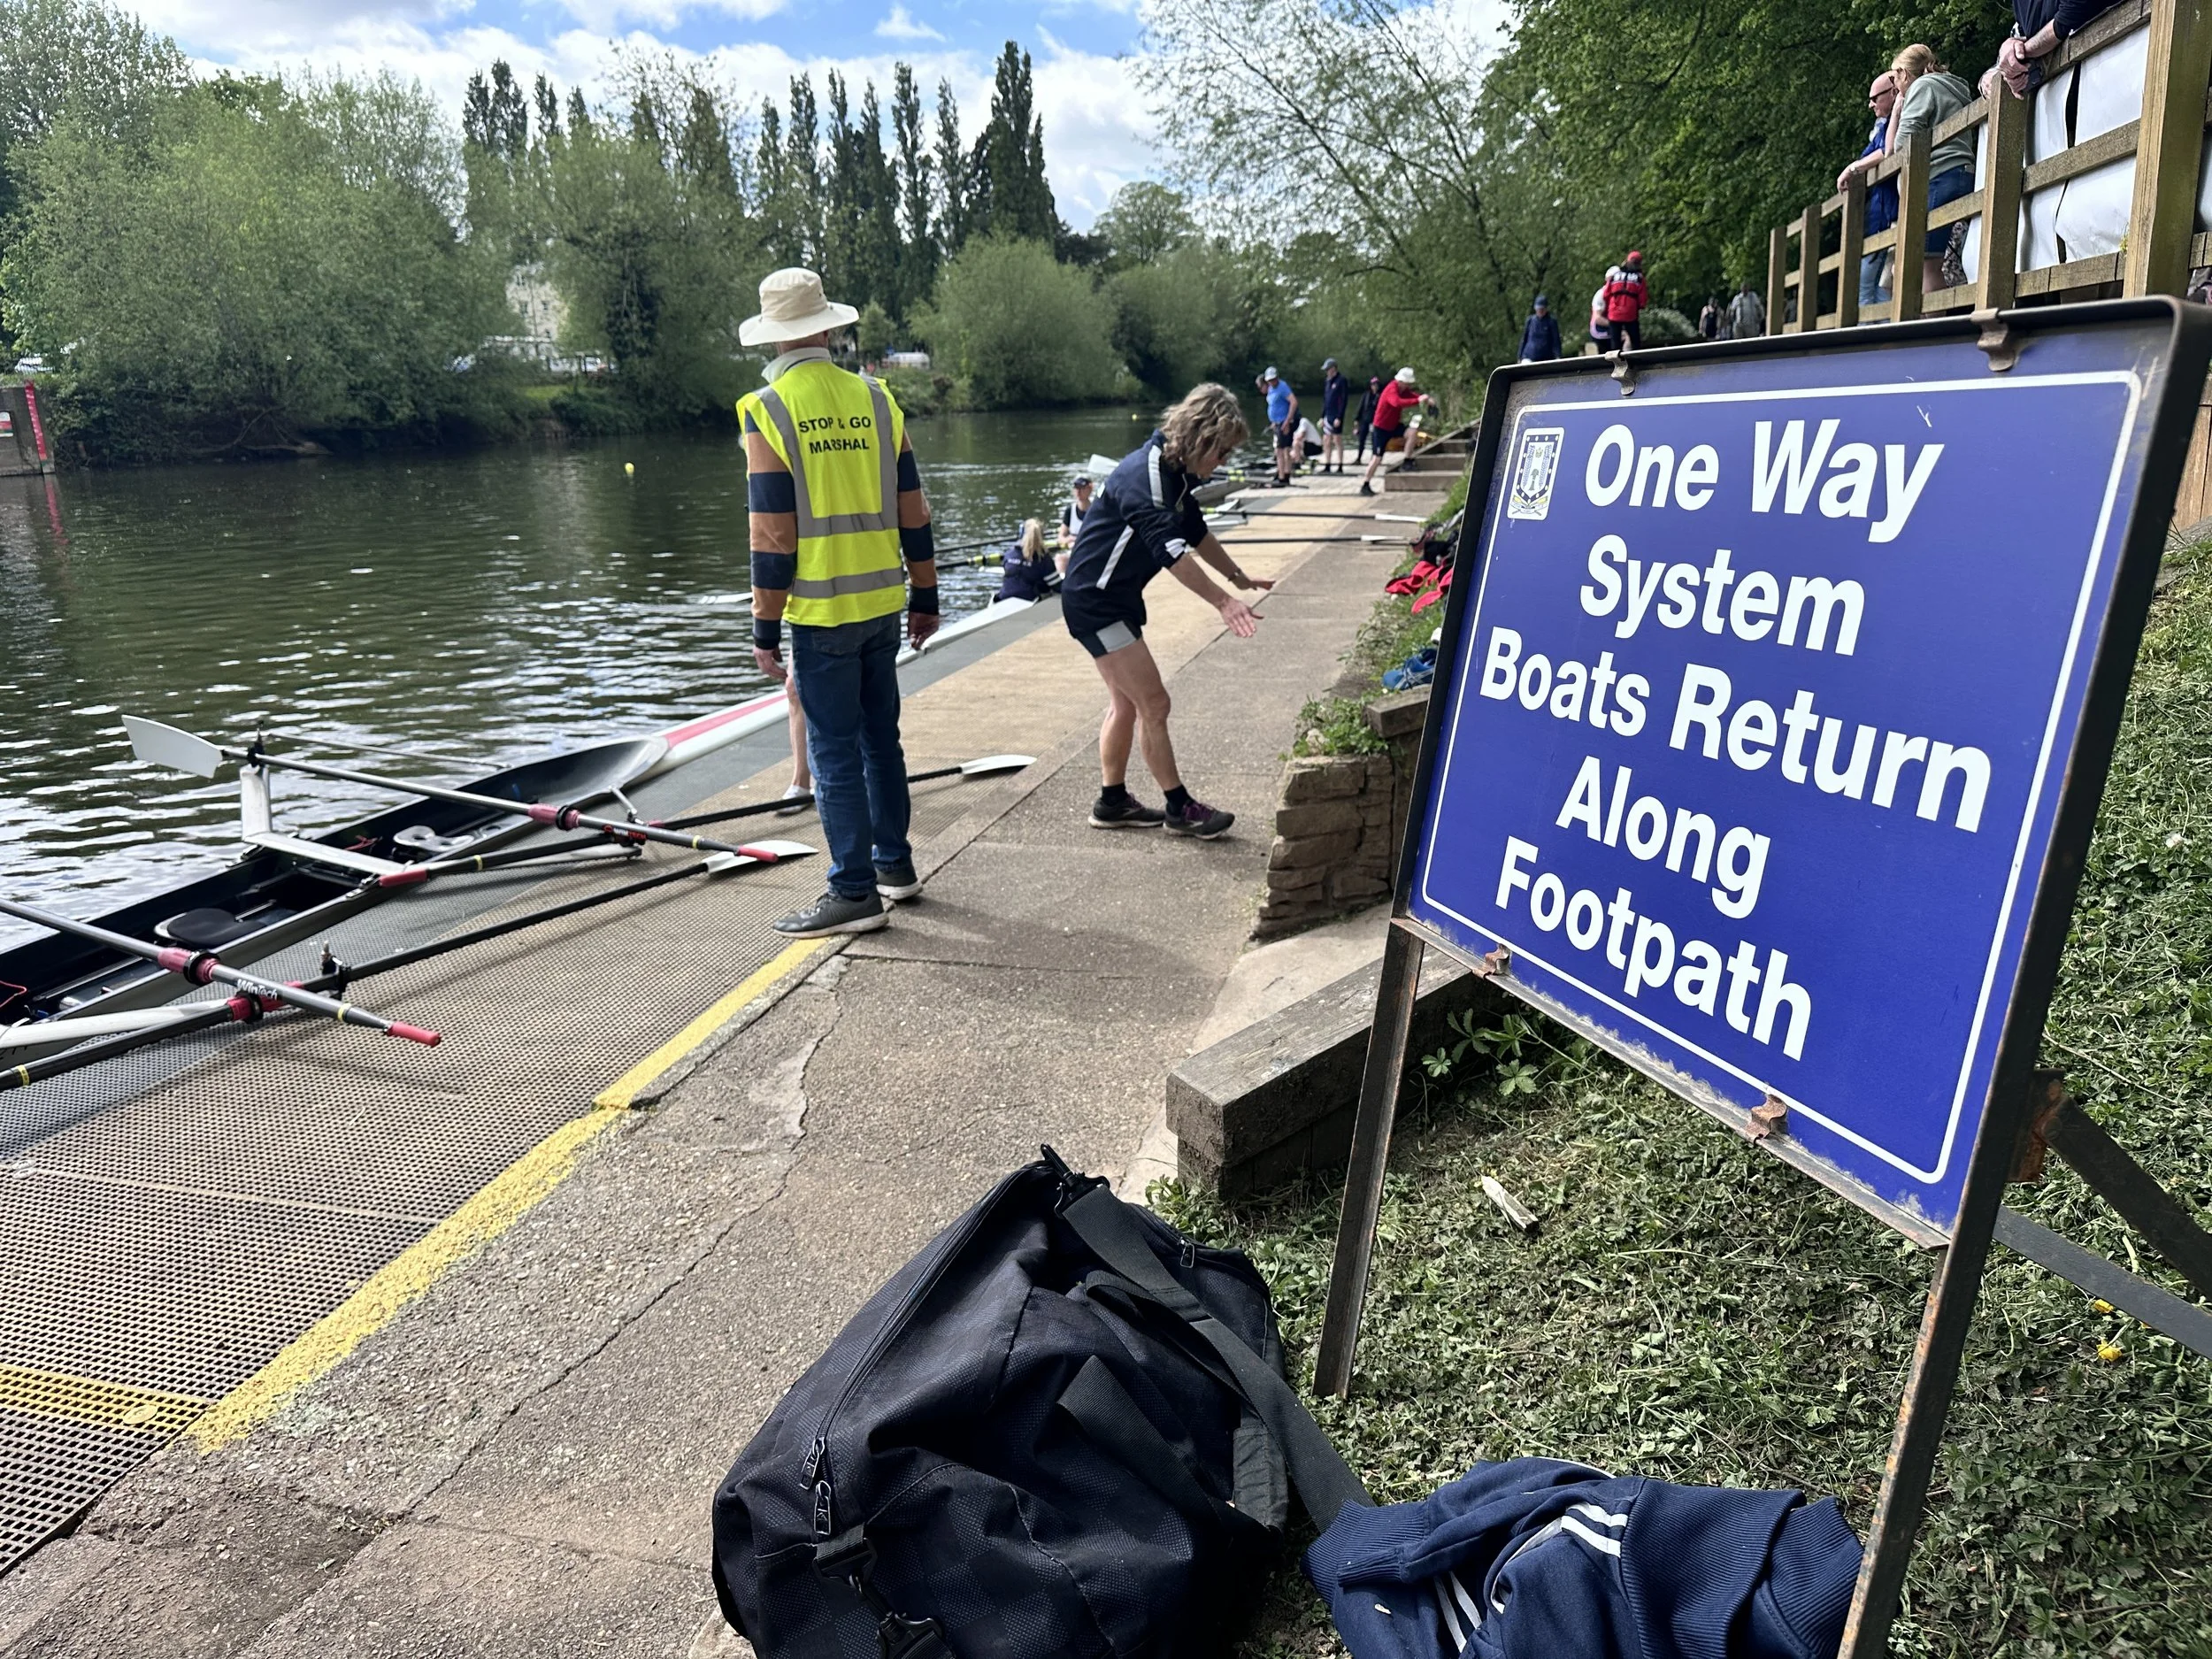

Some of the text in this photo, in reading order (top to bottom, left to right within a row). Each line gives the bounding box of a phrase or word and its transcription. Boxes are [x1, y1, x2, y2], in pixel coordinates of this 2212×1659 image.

[799, 415, 872, 433] STOP & GO
[809, 438, 870, 455] MARSHAL
[1584, 418, 1947, 543] One Way
[1578, 533, 1866, 657] System
[1479, 625, 1993, 834] Boats Return
[1554, 754, 1772, 920] Along
[1494, 834, 1813, 1063] Footpath
